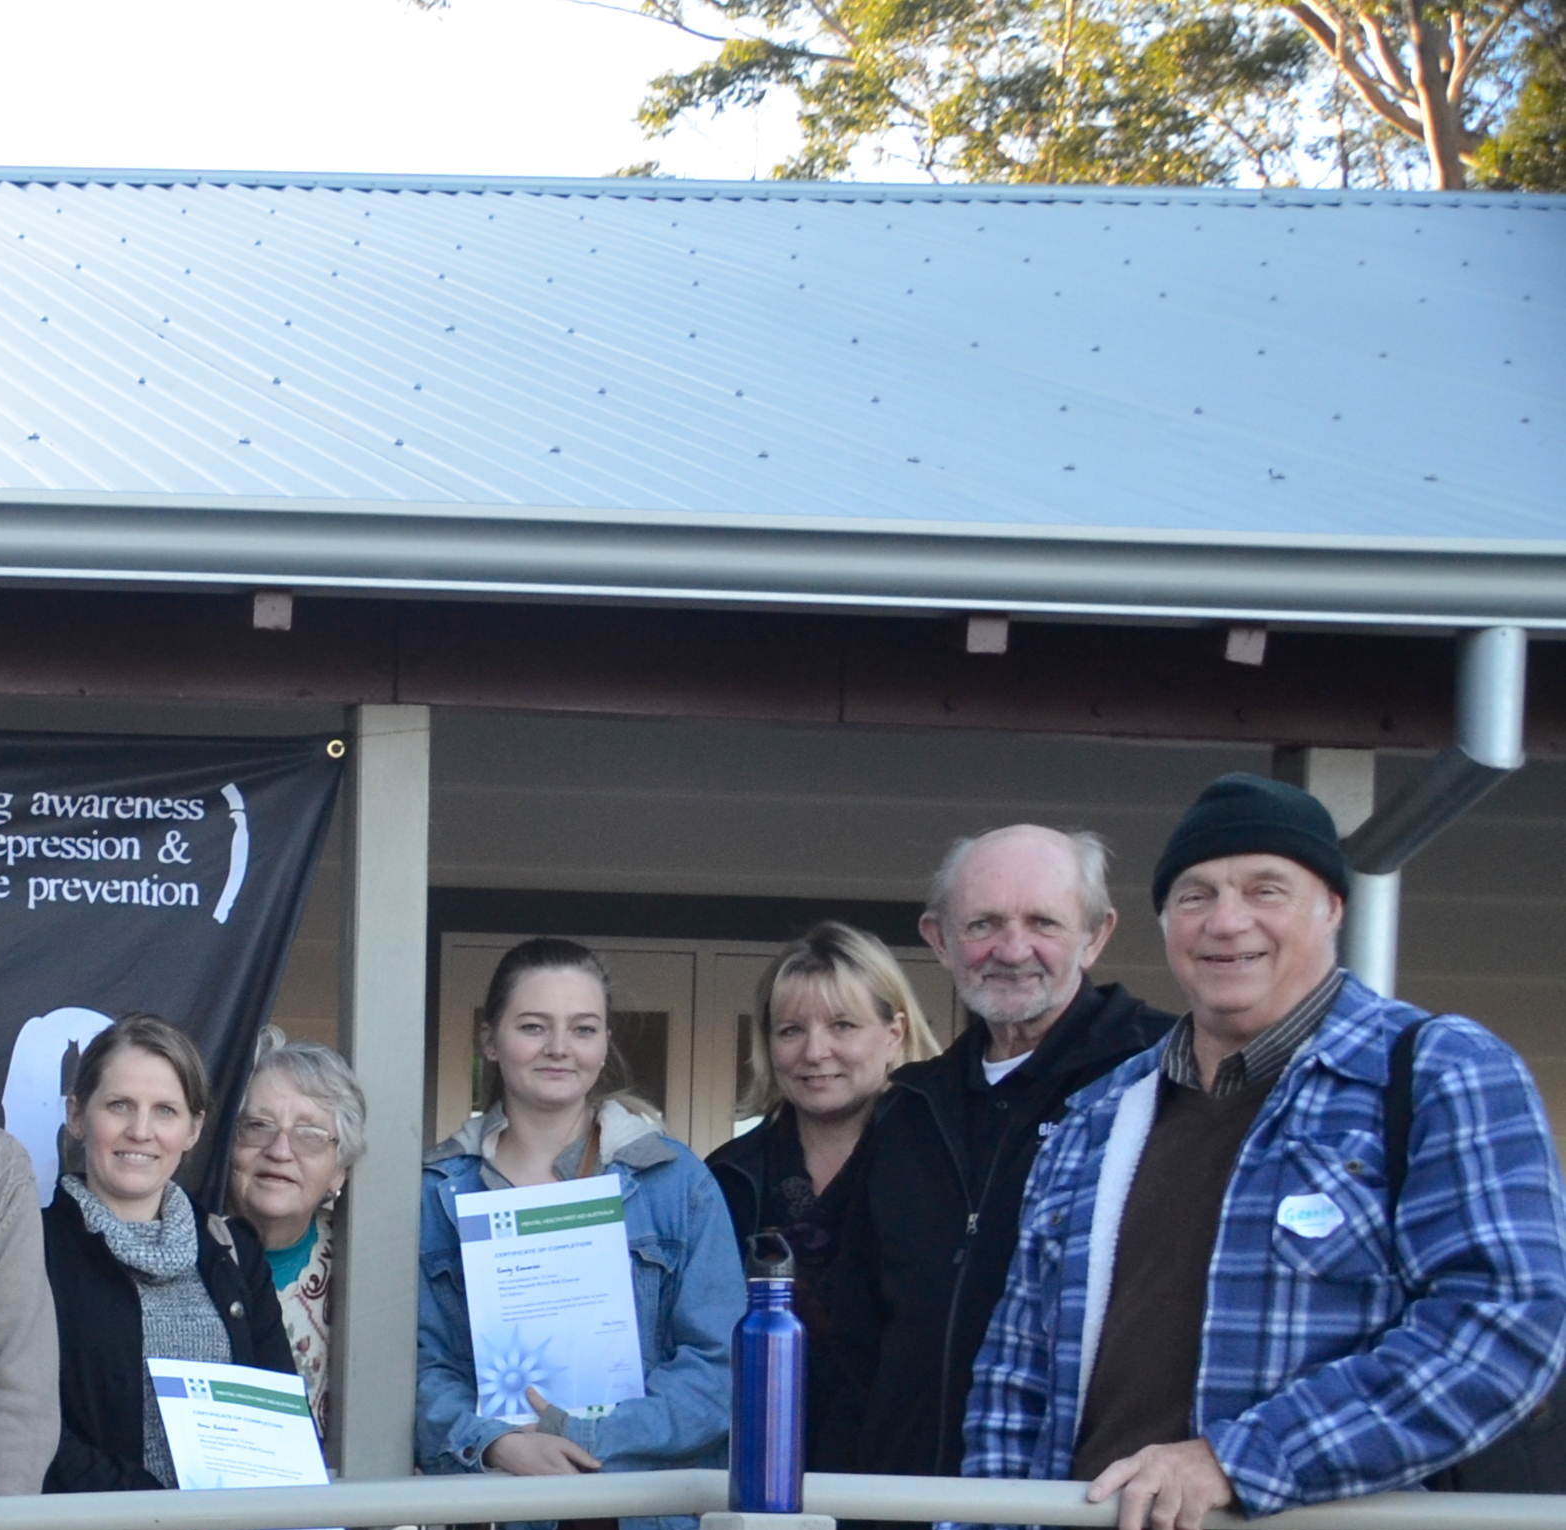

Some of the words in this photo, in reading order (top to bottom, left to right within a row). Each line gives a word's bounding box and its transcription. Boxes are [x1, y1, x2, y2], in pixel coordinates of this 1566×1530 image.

[30, 791, 205, 820] awareness
[157, 830, 192, 864] &
[28, 874, 200, 909] prevention
[494, 1248, 535, 1257] CERTIFICATE
[548, 1240, 592, 1251] COMPLETION
